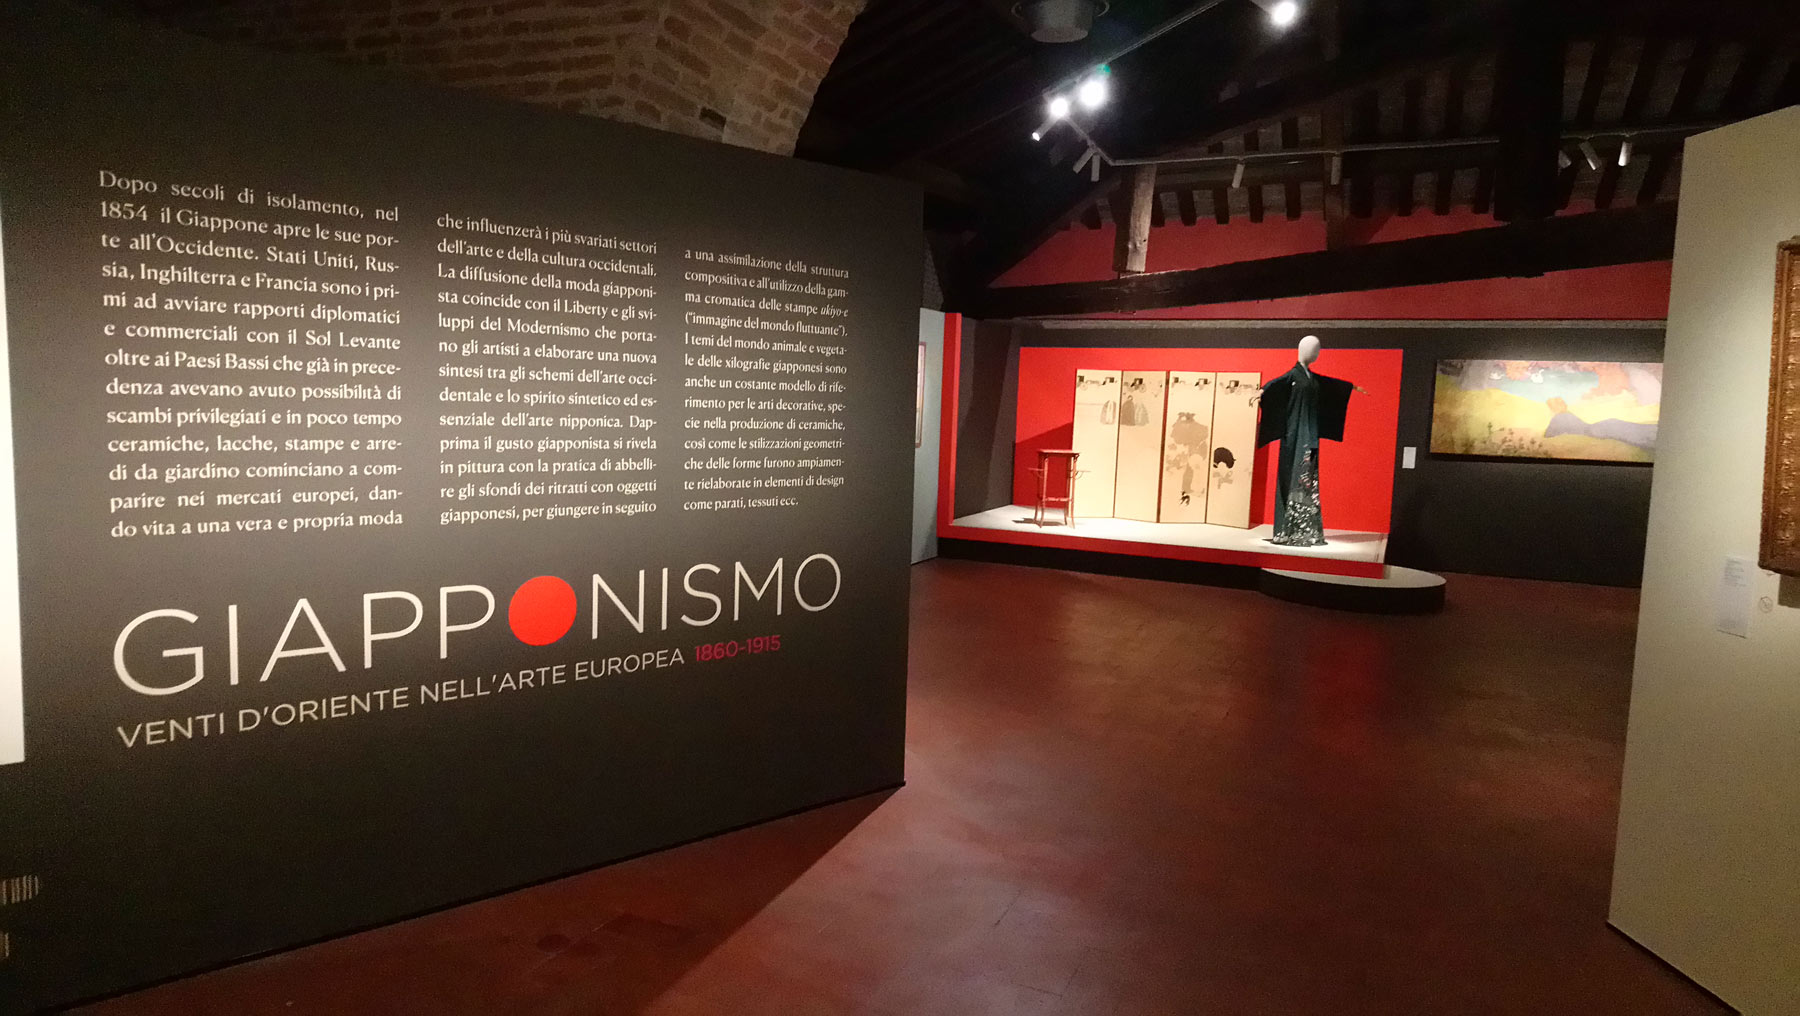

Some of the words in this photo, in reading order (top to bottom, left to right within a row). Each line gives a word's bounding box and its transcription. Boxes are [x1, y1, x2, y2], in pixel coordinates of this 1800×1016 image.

[99, 170, 158, 195] Dopo
[171, 184, 225, 201] secoli
[237, 187, 254, 205] di
[267, 191, 364, 219] isolamento,
[375, 206, 399, 222] nel
[101, 200, 148, 222] 1854
[160, 207, 171, 224] il
[176, 209, 269, 234] Giappone
[273, 223, 311, 240] apre
[315, 223, 330, 240] le
[334, 230, 362, 244] sue
[366, 234, 400, 249] por-
[101, 233, 121, 249] te
[129, 233, 259, 261] all'Occidente.
[266, 246, 307, 265] Stati
[314, 250, 359, 271] Uniti,
[365, 255, 400, 273] Rus-
[437, 238, 494, 258] dell'arte
[496, 249, 505, 259] e
[507, 246, 539, 263] della
[541, 251, 586, 269] cultura
[588, 259, 657, 277] occidentali.
[684, 249, 691, 259] a
[695, 251, 714, 262] una
[718, 252, 782, 271] assimilazione
[785, 259, 807, 274] della
[811, 266, 849, 279] struttura
[438, 262, 456, 279] La
[459, 265, 528, 286] diffusione
[531, 272, 562, 289] della
[565, 278, 600, 293] moda
[602, 281, 657, 300] giapponi-
[684, 271, 748, 287] compositiva
[749, 279, 756, 288] e
[756, 276, 804, 293] all'utilizzo
[804, 282, 826, 296] della
[827, 288, 849, 299] gam-
[103, 291, 127, 308] mi
[133, 292, 157, 310] ad
[163, 296, 227, 314] avviare
[233, 302, 305, 320] rapporti
[310, 303, 401, 325] diplomatici
[685, 293, 701, 303] ma
[704, 295, 756, 309] cromatica
[758, 297, 782, 312] delle
[784, 303, 818, 317] stampe
[820, 304, 849, 319] ukiyo-e
[104, 324, 116, 336] e
[125, 325, 238, 342] commerciali
[246, 331, 280, 344] con
[287, 328, 297, 345] il
[305, 330, 331, 346] Sol
[339, 331, 401, 350] Levante
[438, 312, 474, 333] luppi
[480, 316, 502, 332] del
[507, 318, 590, 338] Modernismo
[594, 325, 617, 340] che
[621, 331, 657, 344] porta-
[438, 362, 484, 378] sintesi
[487, 367, 507, 380] tra
[509, 365, 526, 383] gli
[529, 366, 574, 382] schemi
[577, 368, 626, 385] dell'arte
[628, 373, 657, 386] occi-
[685, 353, 695, 367] le
[697, 354, 723, 368] delle
[725, 356, 771, 372] xilografie
[772, 359, 823, 375] giapponesi
[825, 365, 847, 375] sono
[105, 377, 164, 396] denza
[169, 383, 244, 397] avevano
[248, 385, 297, 398] avuto
[386, 385, 402, 401] di
[106, 406, 172, 424] scambi
[176, 407, 267, 428] privilegiati
[271, 413, 282, 425] e
[286, 409, 302, 425] in
[306, 413, 349, 429] poco
[353, 413, 402, 429] tempo
[439, 411, 495, 427] senziale
[501, 412, 554, 427] dell'arte
[559, 414, 624, 431] nipponica.
[629, 415, 657, 431] Dap-
[684, 416, 701, 429] cie
[703, 416, 727, 430] nella
[730, 417, 785, 432] produzione
[786, 417, 796, 430] di
[798, 418, 846, 431] ceramiche,
[107, 434, 210, 453] ceramiche,
[217, 435, 278, 453] lacche,
[284, 438, 345, 455] stampe
[350, 439, 361, 451] e
[366, 439, 403, 451] arre-
[440, 436, 481, 454] prima
[484, 435, 492, 450] il
[495, 438, 534, 453] gusto
[537, 436, 610, 453] giapponista
[613, 437, 623, 450] si
[626, 436, 657, 450] rivela
[684, 437, 706, 450] così
[708, 440, 737, 450] come
[738, 437, 748, 449] le
[749, 437, 802, 449] stilizzazioni
[803, 438, 845, 452] geometri-
[109, 463, 128, 481] di
[134, 463, 159, 481] da
[164, 462, 241, 484] giardino
[245, 462, 344, 478] cominciano
[349, 465, 358, 476] a
[363, 464, 403, 476] com-
[440, 460, 454, 474] in
[457, 460, 505, 478] pittura
[508, 462, 534, 473] con
[538, 458, 549, 472] la
[552, 458, 597, 476] pratica
[599, 458, 612, 472] di
[614, 457, 657, 471] abbelli-
[684, 457, 704, 470] che
[705, 456, 731, 470] delle
[732, 456, 762, 469] forme
[763, 456, 796, 469] furono
[797, 456, 845, 470] ampiamen-
[110, 492, 166, 514] parire
[177, 490, 205, 507] nei
[216, 488, 282, 506] mercati
[292, 487, 359, 506] europei,
[368, 485, 403, 501] dan-
[440, 488, 455, 498] re
[458, 482, 475, 501] gli
[478, 481, 521, 497] sfondi
[524, 481, 545, 496] dei
[548, 481, 588, 495] ritratti
[590, 483, 614, 494] con
[616, 479, 657, 496] oggetti
[440, 505, 520, 526] giapponesi,
[522, 507, 545, 522] per
[546, 504, 600, 520] giungere
[602, 502, 613, 515] in
[615, 500, 657, 517] seguito
[683, 501, 713, 511] come
[714, 496, 747, 512] parati,
[748, 495, 779, 508] tessuti
[779, 497, 799, 507] ecc.
[116, 711, 226, 748] VENTI
[238, 687, 410, 732] D'ORIENTE
[420, 663, 567, 705] NELL'ARTE
[575, 648, 685, 681] EUROPEA
[695, 635, 781, 661] 1860-1915
